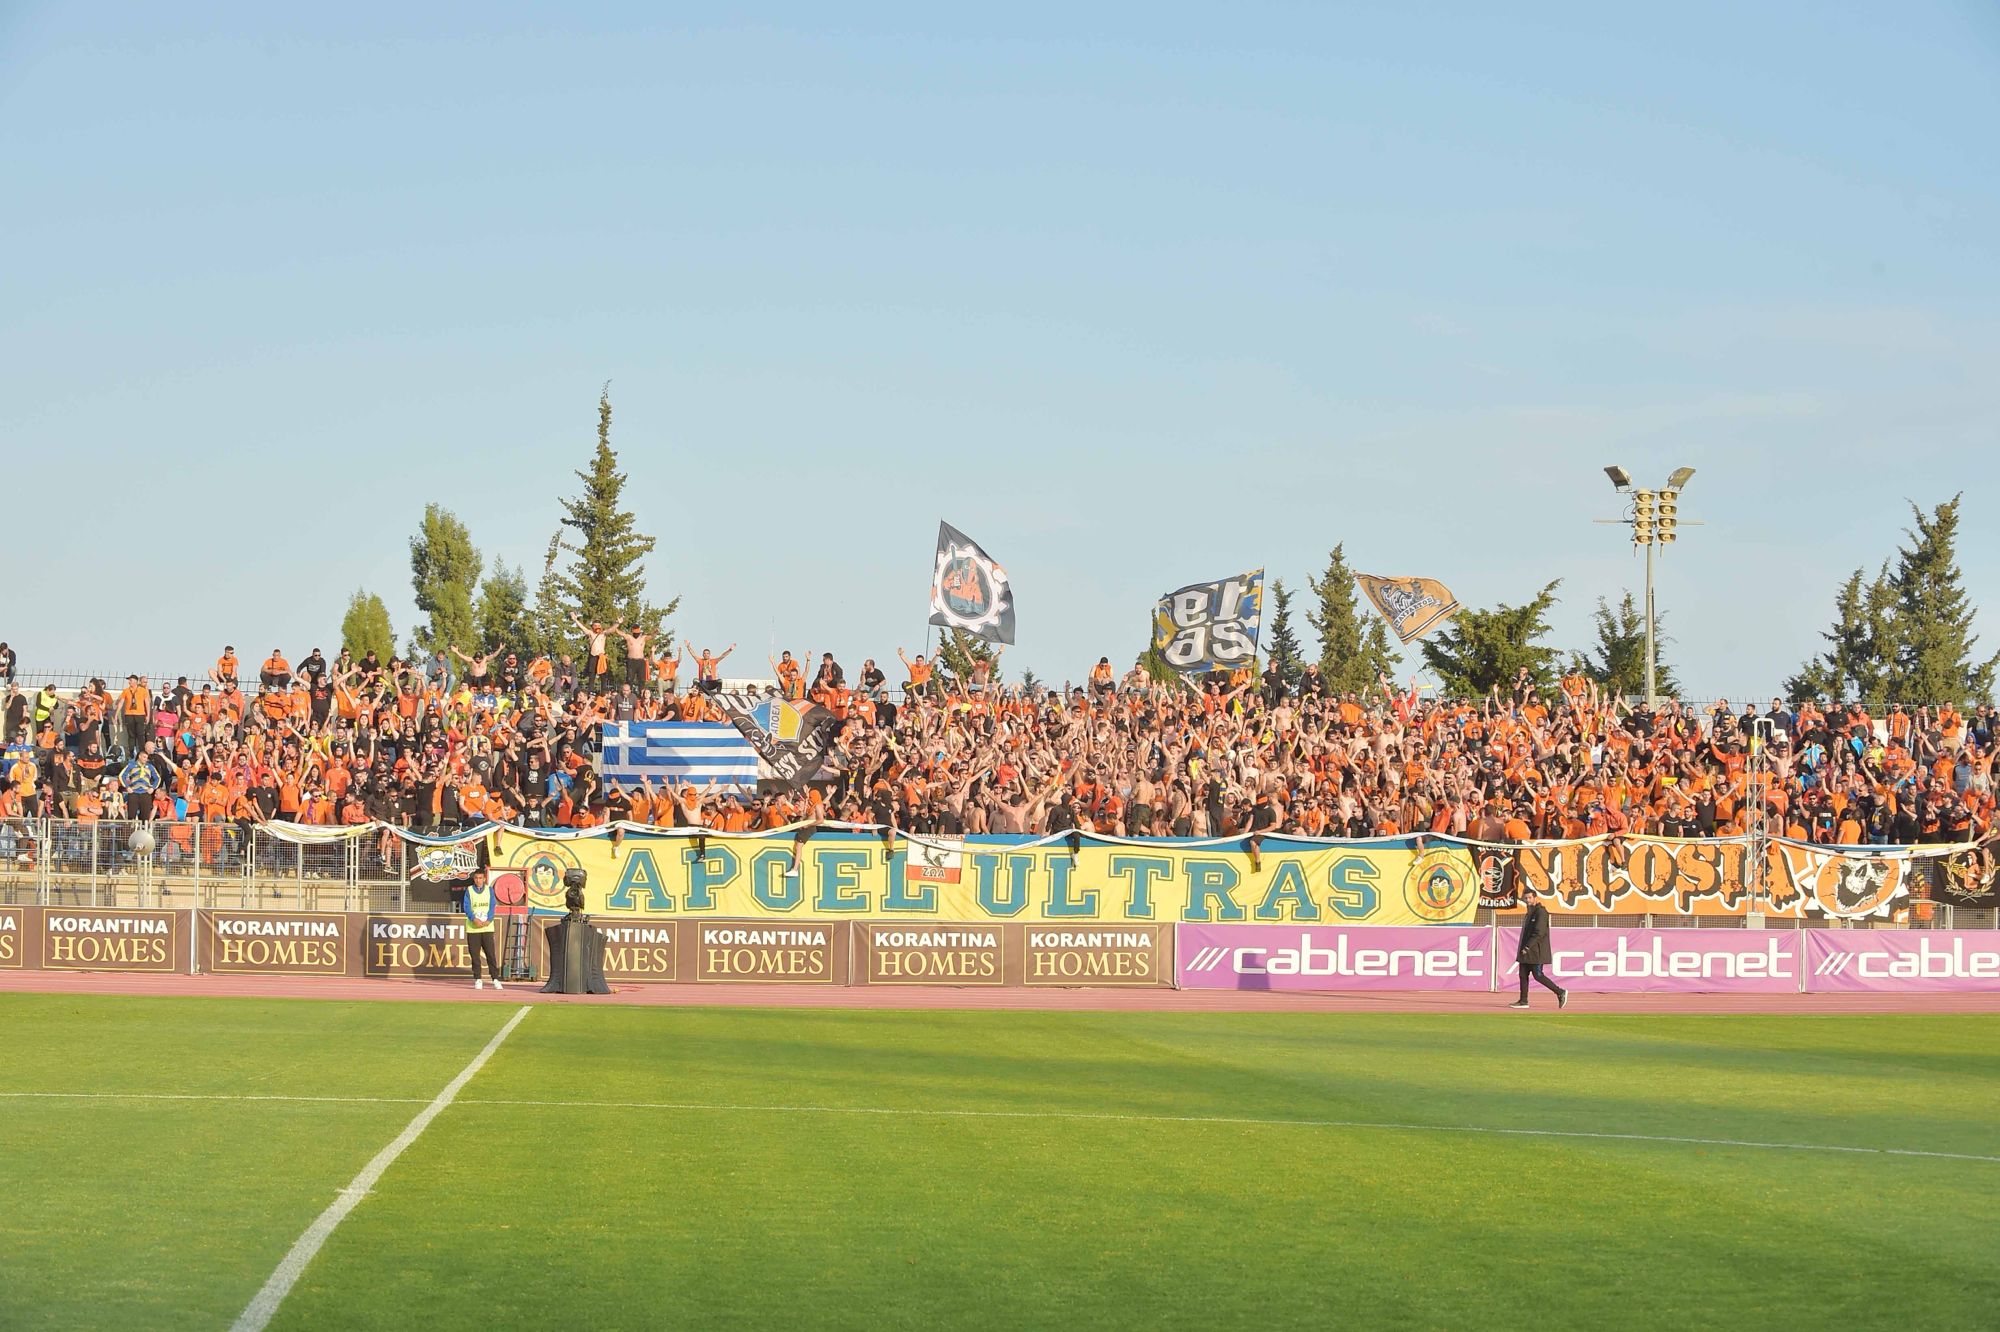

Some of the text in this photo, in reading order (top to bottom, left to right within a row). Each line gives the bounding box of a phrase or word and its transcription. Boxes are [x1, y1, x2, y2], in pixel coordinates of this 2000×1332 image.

[1165, 622, 1256, 665] as
[606, 844, 1382, 922] APOEL ULTRAS
[922, 867, 946, 879] ΖΩΑ
[1517, 842, 1801, 912] NICOSIA
[1413, 896, 1469, 918] APOEL
[50, 917, 168, 934] KORANTINA
[218, 920, 339, 937] KORANTINA
[373, 923, 465, 940] KORANTI
[704, 930, 826, 946] KORANTINA
[52, 935, 166, 963] HOMES
[221, 939, 338, 966] HOMES
[875, 932, 997, 948] KORANTINA
[1031, 932, 1152, 948] KORANTINA
[603, 947, 668, 973] MES
[706, 949, 824, 975] HOMES
[878, 951, 995, 977] HOMES
[1033, 951, 1150, 977] HOMES
[1233, 933, 1484, 977] cablenet
[1552, 936, 1792, 978] cablenet
